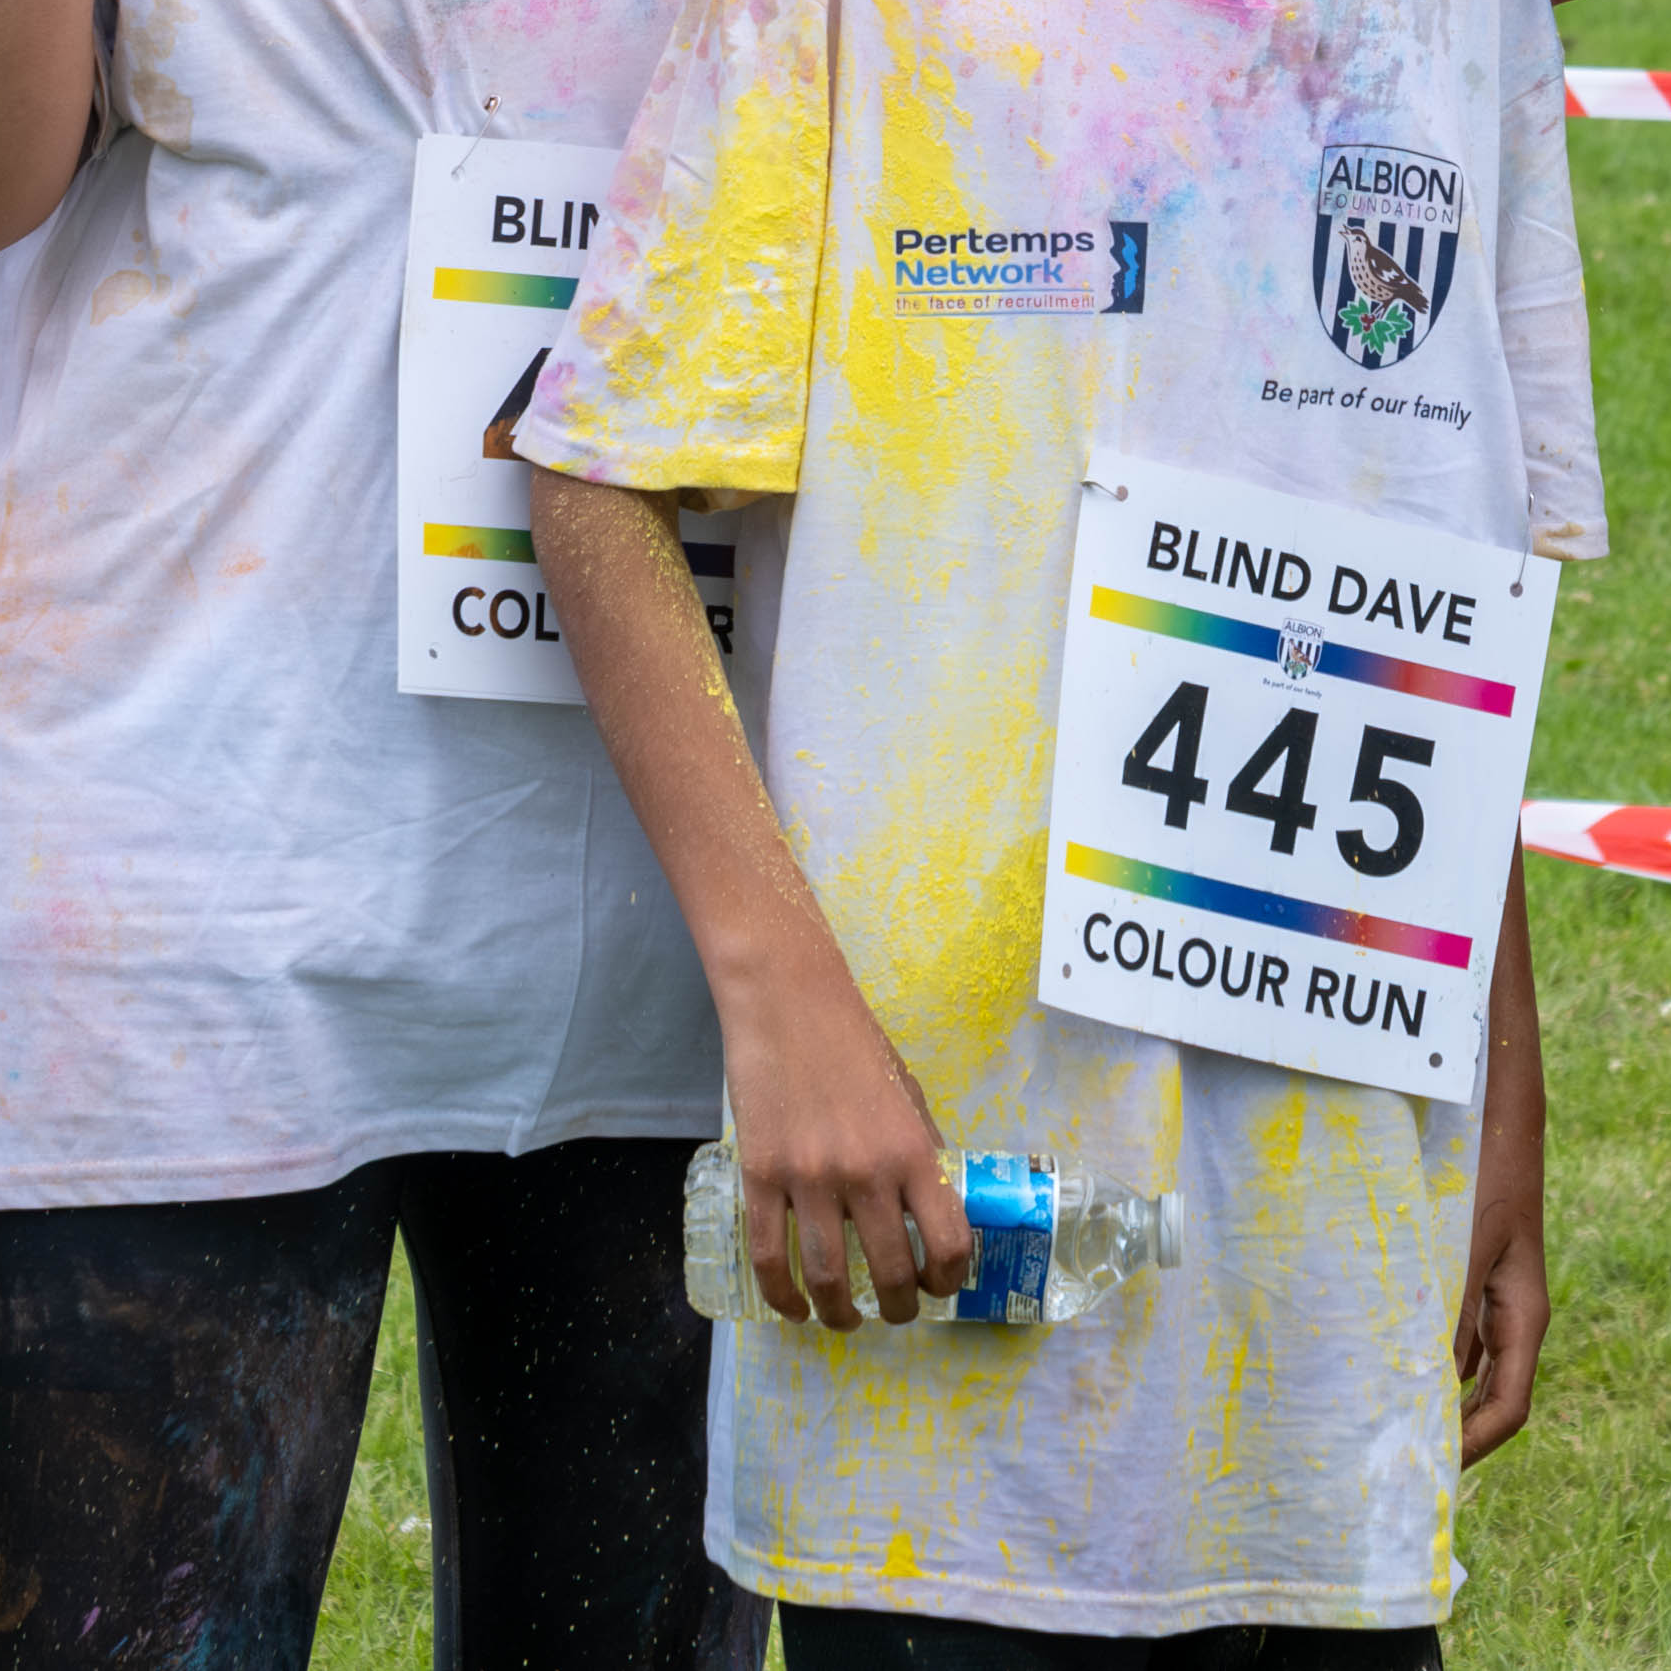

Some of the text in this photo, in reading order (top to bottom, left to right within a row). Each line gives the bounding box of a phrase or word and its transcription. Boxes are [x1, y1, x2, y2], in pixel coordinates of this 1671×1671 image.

[1326, 155, 1457, 206] ALBION
[1323, 191, 1454, 225] FOUNDATION
[895, 228, 1095, 258] Pertemps
[895, 258, 1064, 286] Network
[896, 294, 1095, 311] the face of recruitment
[1261, 380, 1472, 431] Be part of our family
[1147, 520, 1477, 646] BLIND DAVE
[1284, 620, 1322, 638] ALBION
[1121, 681, 1437, 877] 445
[1082, 912, 1427, 1038] COLOUR RUN
